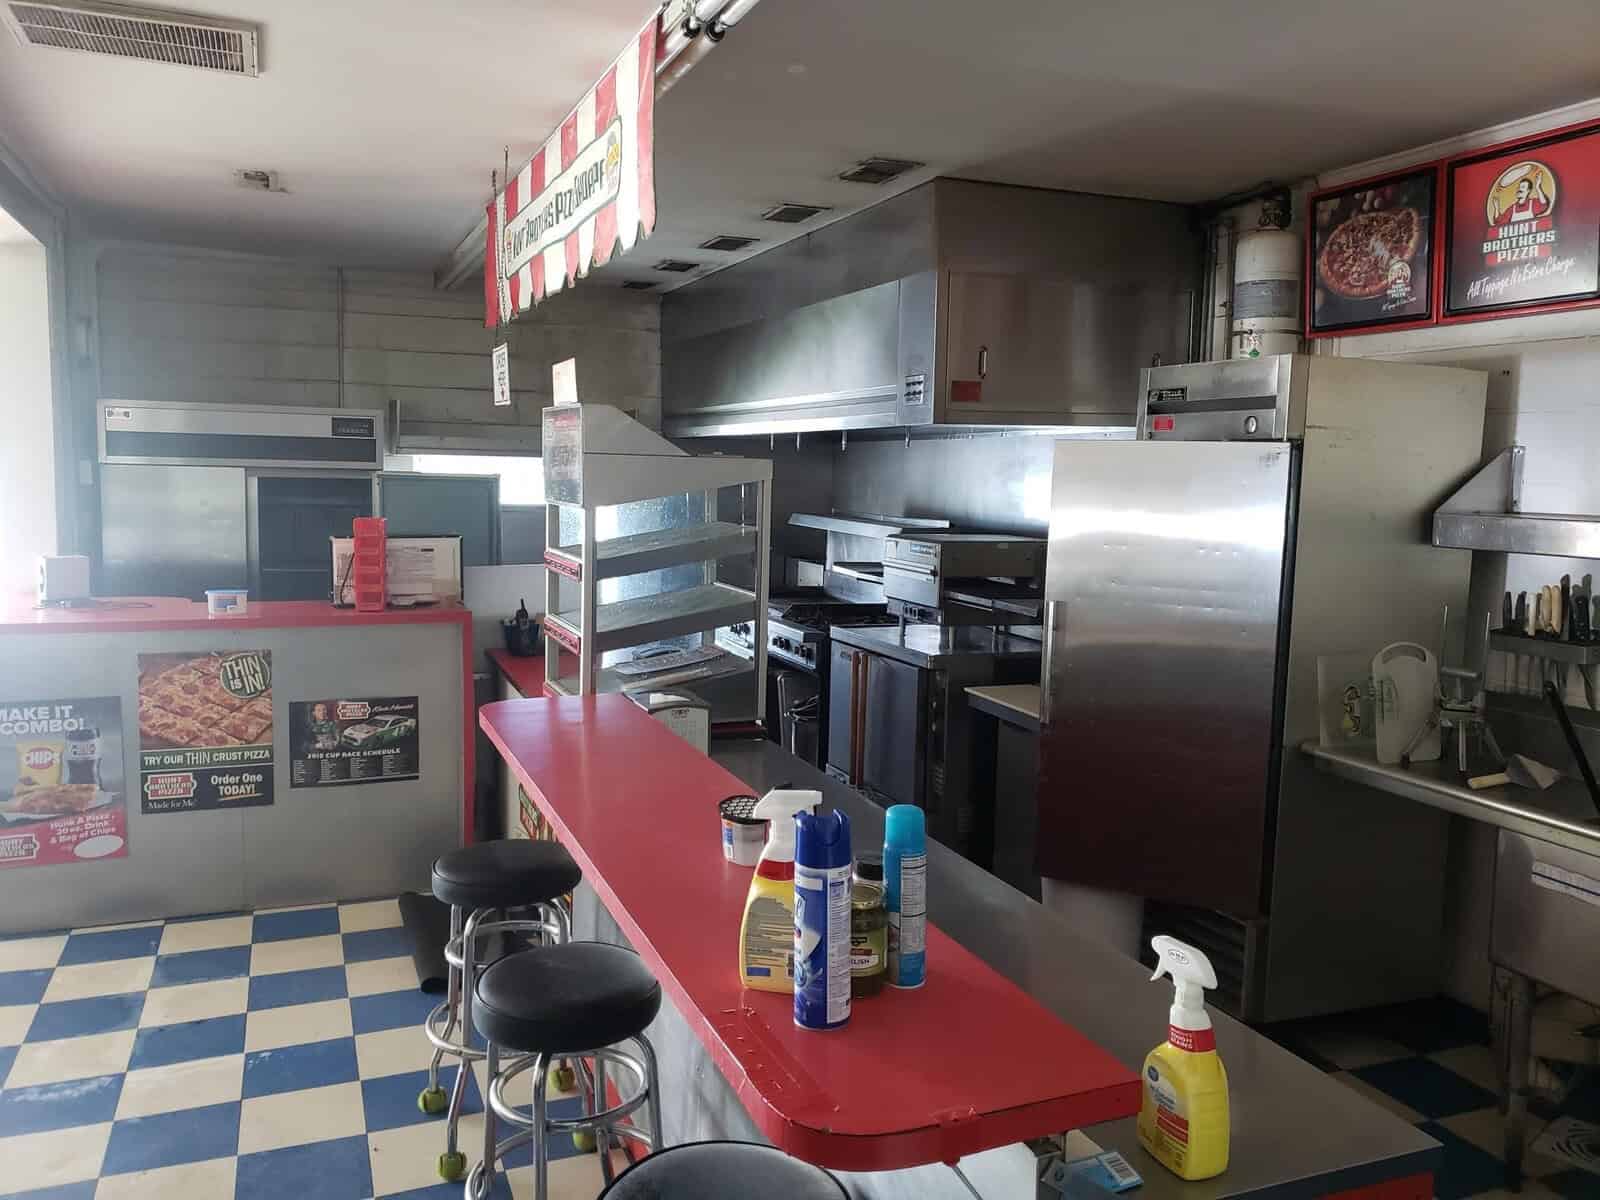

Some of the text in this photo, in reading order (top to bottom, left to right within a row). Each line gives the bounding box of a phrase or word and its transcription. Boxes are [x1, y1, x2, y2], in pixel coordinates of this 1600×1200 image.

[1499, 221, 1538, 239] HUNT
[1483, 230, 1555, 252] BROTHERS
[1497, 245, 1539, 263] PIZZA
[222, 655, 260, 680] THIN
[230, 671, 265, 694] IS IN!
[55, 704, 73, 719] IT
[1, 717, 85, 736] COMBO!
[144, 750, 271, 766] TRY OUR THIN CRUST PIZZA
[211, 773, 263, 785] Order One
[218, 784, 256, 796] TODAY!
